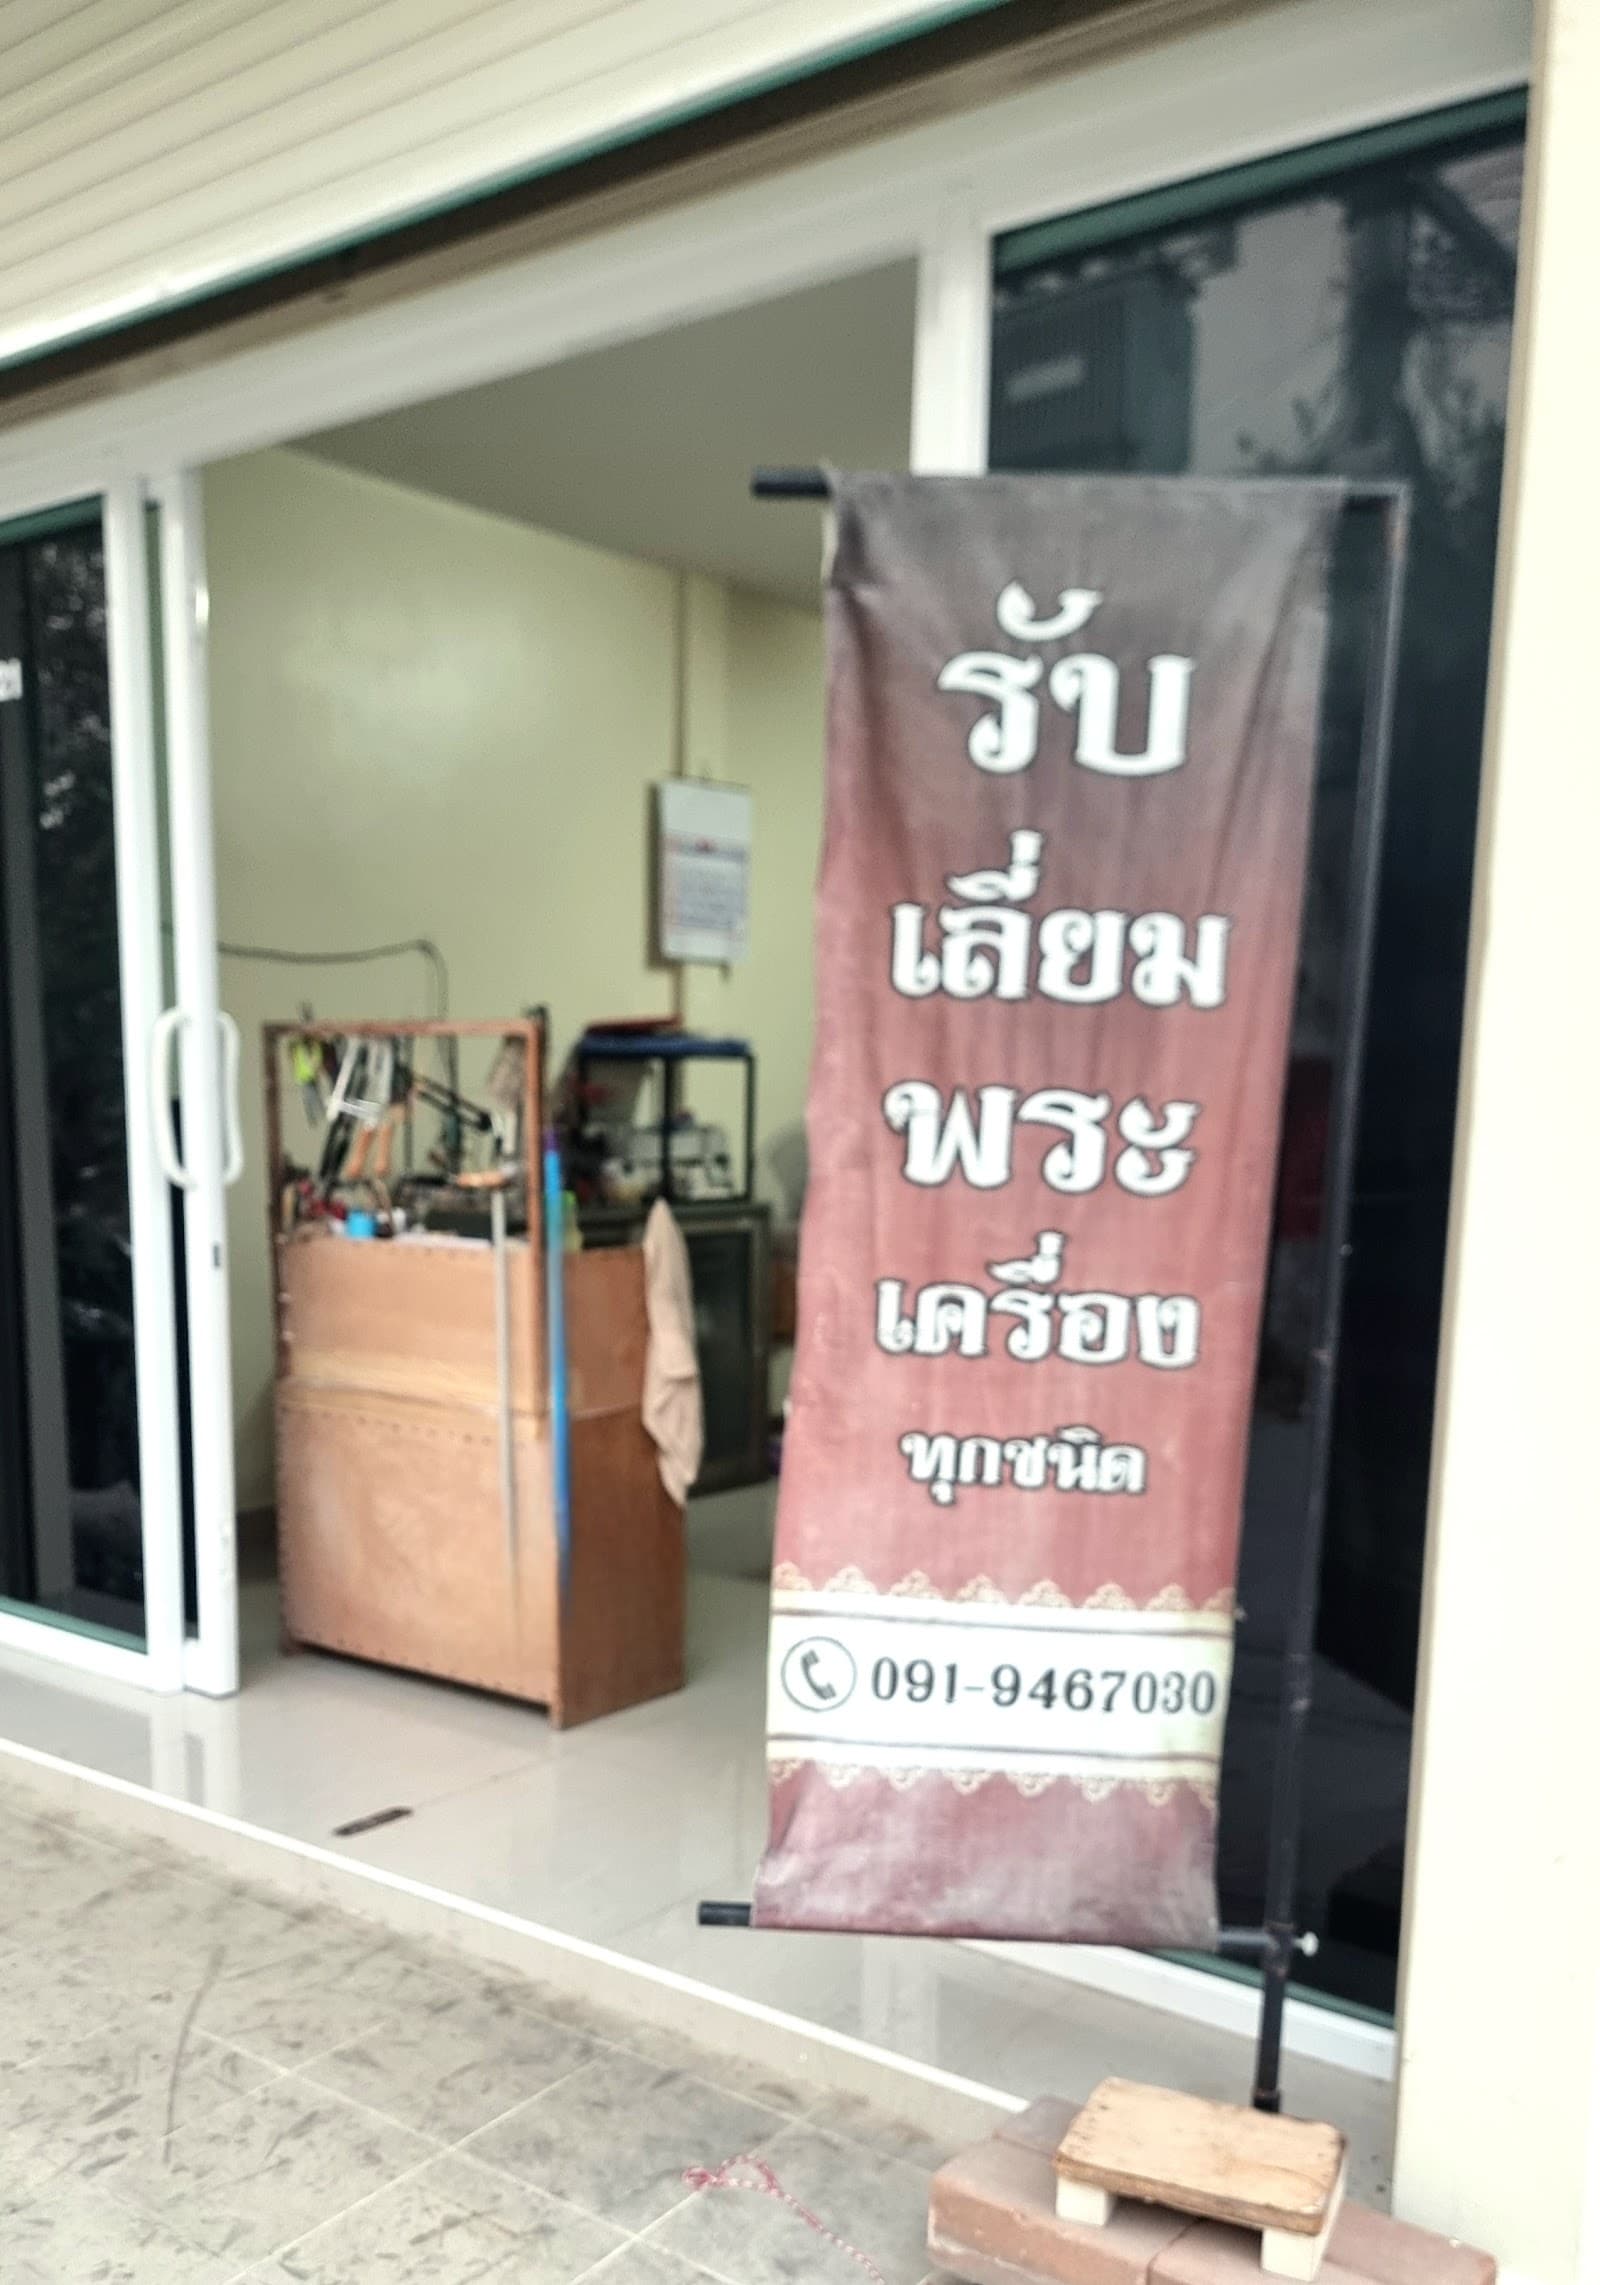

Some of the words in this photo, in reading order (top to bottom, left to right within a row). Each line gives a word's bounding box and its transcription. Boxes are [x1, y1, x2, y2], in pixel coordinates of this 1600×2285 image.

[938, 580, 1195, 777] รับ
[890, 829, 1230, 1008] เลี่ยม
[884, 1080, 1201, 1197] พระ
[874, 1229, 1201, 1370] เครื่อง
[899, 1424, 1148, 1507] ทุกชนิด
[870, 1656, 1217, 1714] 091-9467030
